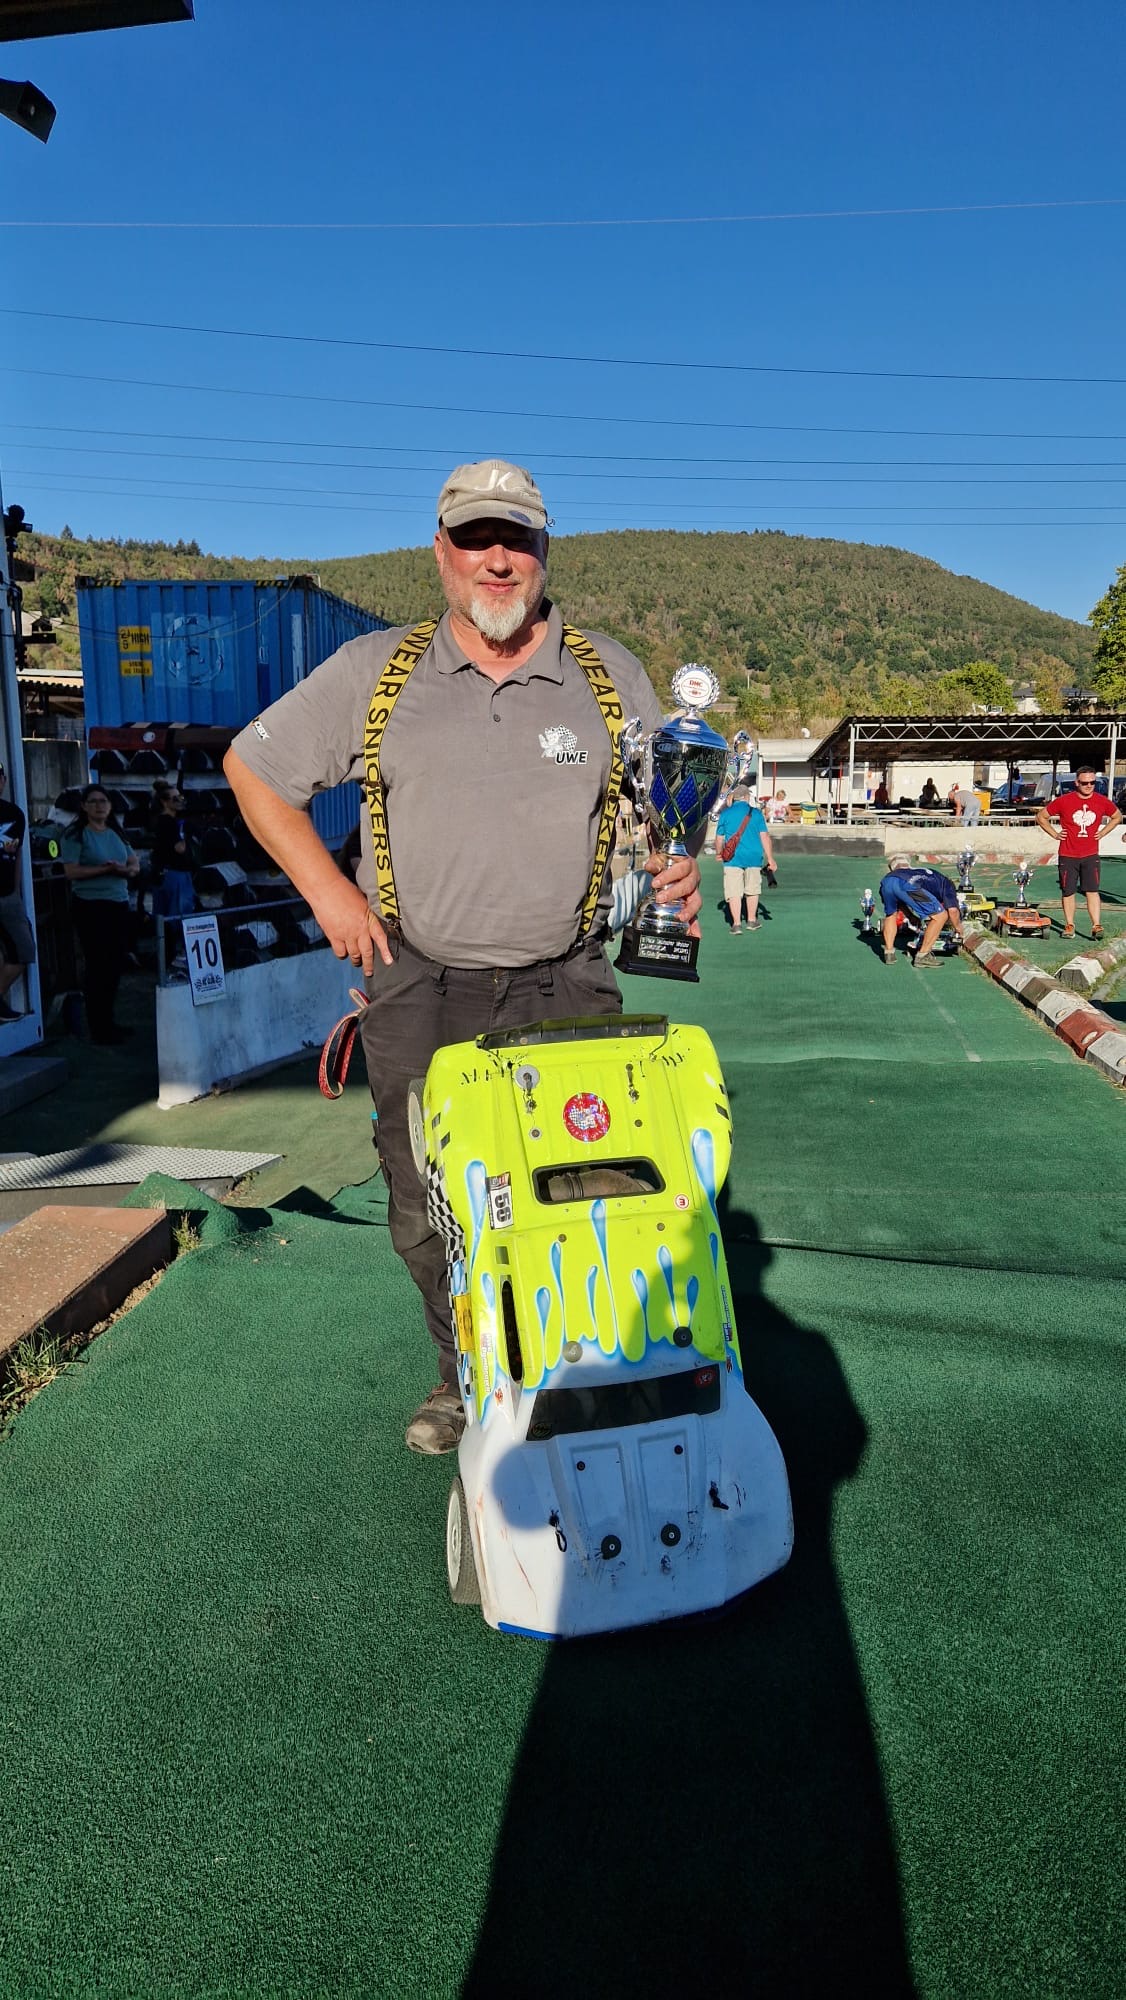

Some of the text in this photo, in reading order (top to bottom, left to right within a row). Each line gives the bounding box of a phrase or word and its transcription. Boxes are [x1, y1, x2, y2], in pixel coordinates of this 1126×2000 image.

[556, 751, 587, 764] UWE
[366, 707, 391, 871] SNICKERS
[191, 938, 218, 969] 10
[495, 1192, 511, 1223] 56
